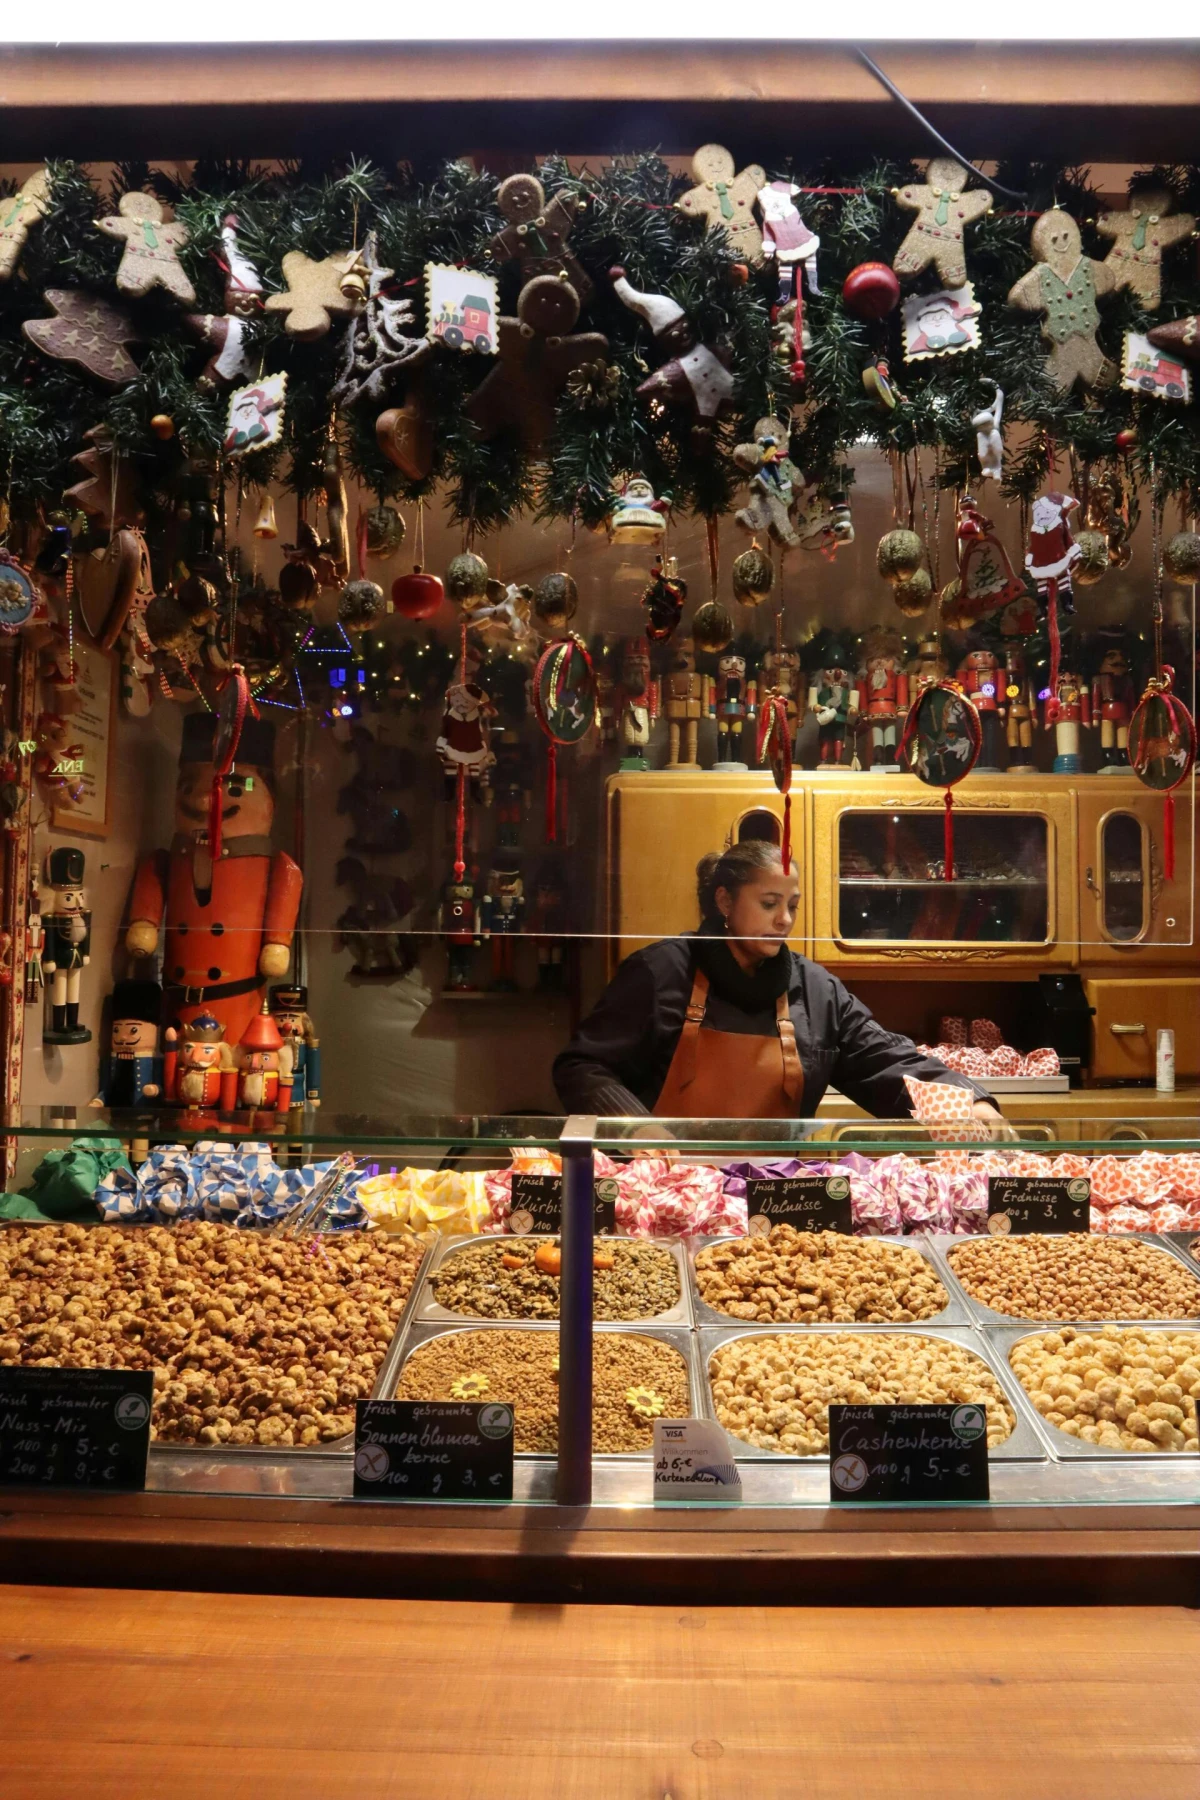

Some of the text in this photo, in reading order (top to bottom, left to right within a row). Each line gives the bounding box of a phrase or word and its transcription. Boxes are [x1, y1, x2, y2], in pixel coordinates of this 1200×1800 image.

[517, 1177, 544, 1187] frisch
[752, 1182, 776, 1195] frisch
[993, 1178, 1019, 1190] frisch
[1002, 1189, 1058, 1203] Erdnüsse
[759, 1194, 822, 1214] Walnüsse
[1004, 1207, 1020, 1216] 100
[1021, 1210, 1029, 1220] g
[534, 1221, 551, 1230] 100
[829, 1221, 837, 1229] €
[363, 1402, 472, 1420] frisch gebrannte
[838, 1407, 874, 1422] frisch
[356, 1420, 482, 1447] Sonnenblumen
[839, 1426, 972, 1452] Cashewkerne
[959, 1428, 979, 1436] Vegan
[13, 1439, 41, 1452] 100
[47, 1445, 58, 1457] g
[108, 1443, 119, 1455] €
[403, 1447, 450, 1463] kerne
[9, 1458, 36, 1475] 200
[42, 1466, 55, 1480] g
[103, 1466, 115, 1479] €
[656, 1457, 668, 1469] ab
[871, 1463, 898, 1475] 100
[900, 1465, 911, 1485] g
[956, 1464, 970, 1476] €
[380, 1472, 408, 1484] 100
[432, 1473, 443, 1493] g
[489, 1473, 502, 1484] €
